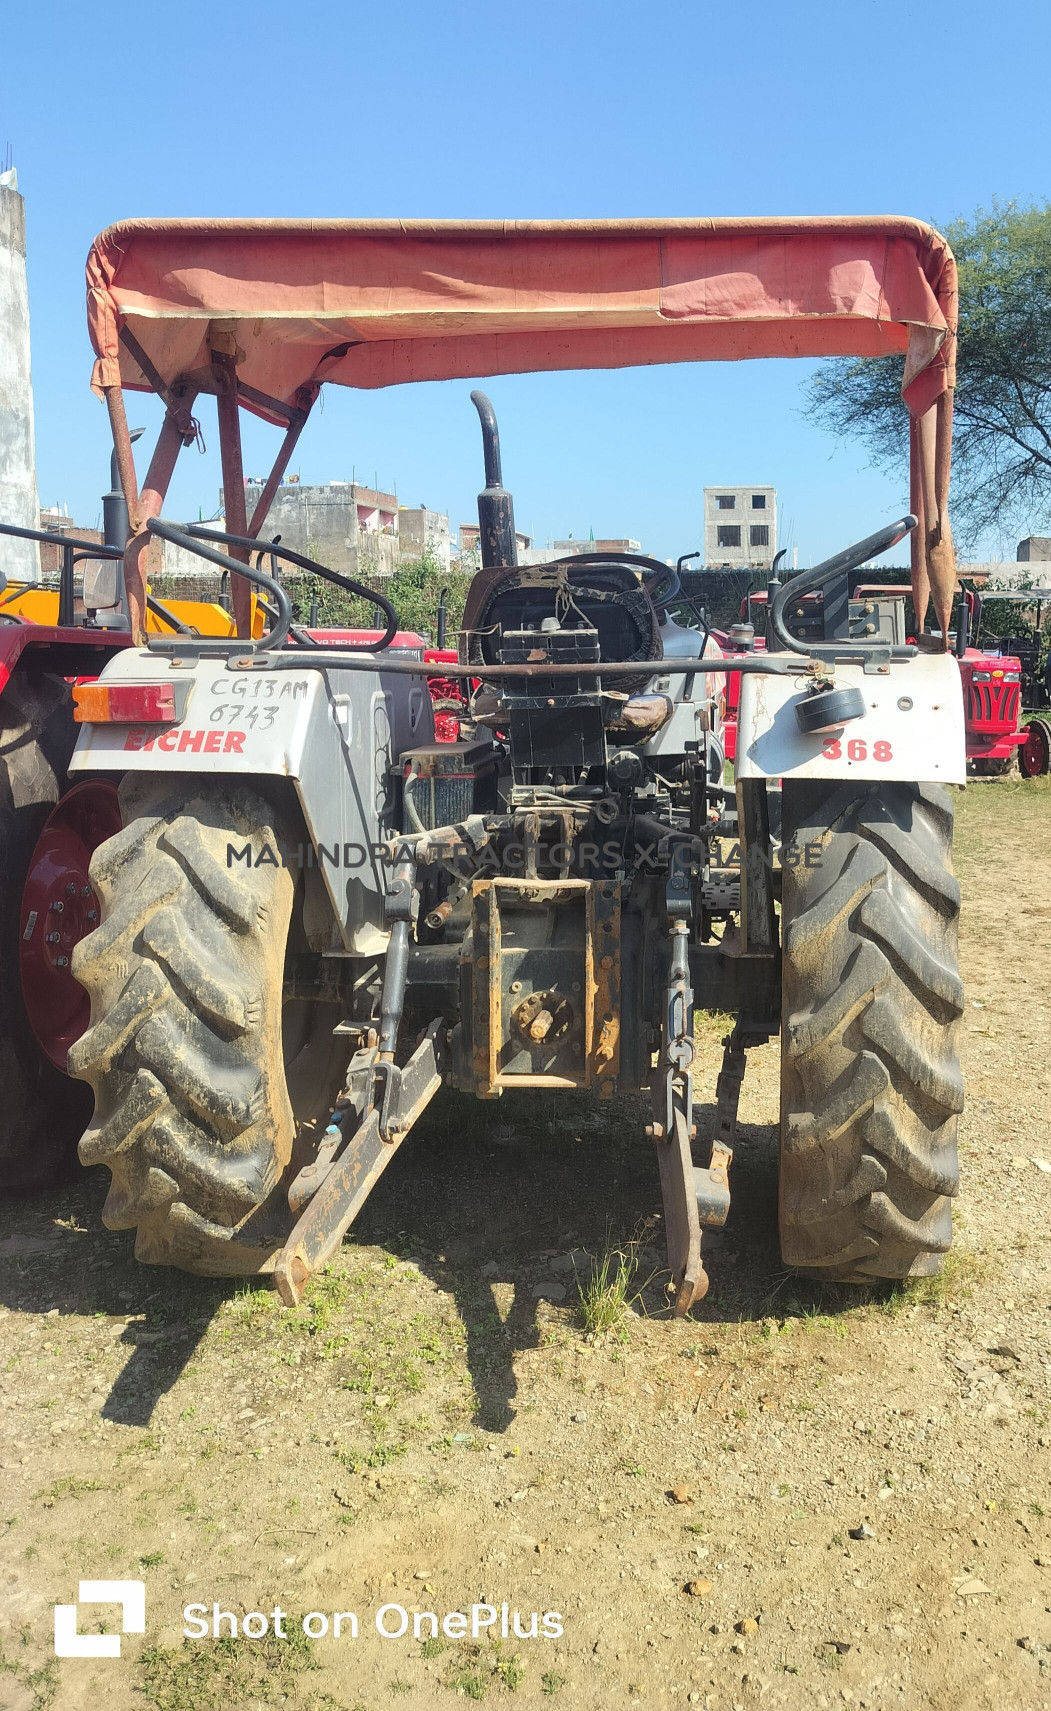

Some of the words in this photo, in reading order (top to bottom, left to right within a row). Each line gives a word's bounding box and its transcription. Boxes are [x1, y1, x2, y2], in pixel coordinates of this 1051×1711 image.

[209, 704, 280, 730] 6743
[123, 729, 247, 753] EICHER
[822, 738, 893, 762] 368
